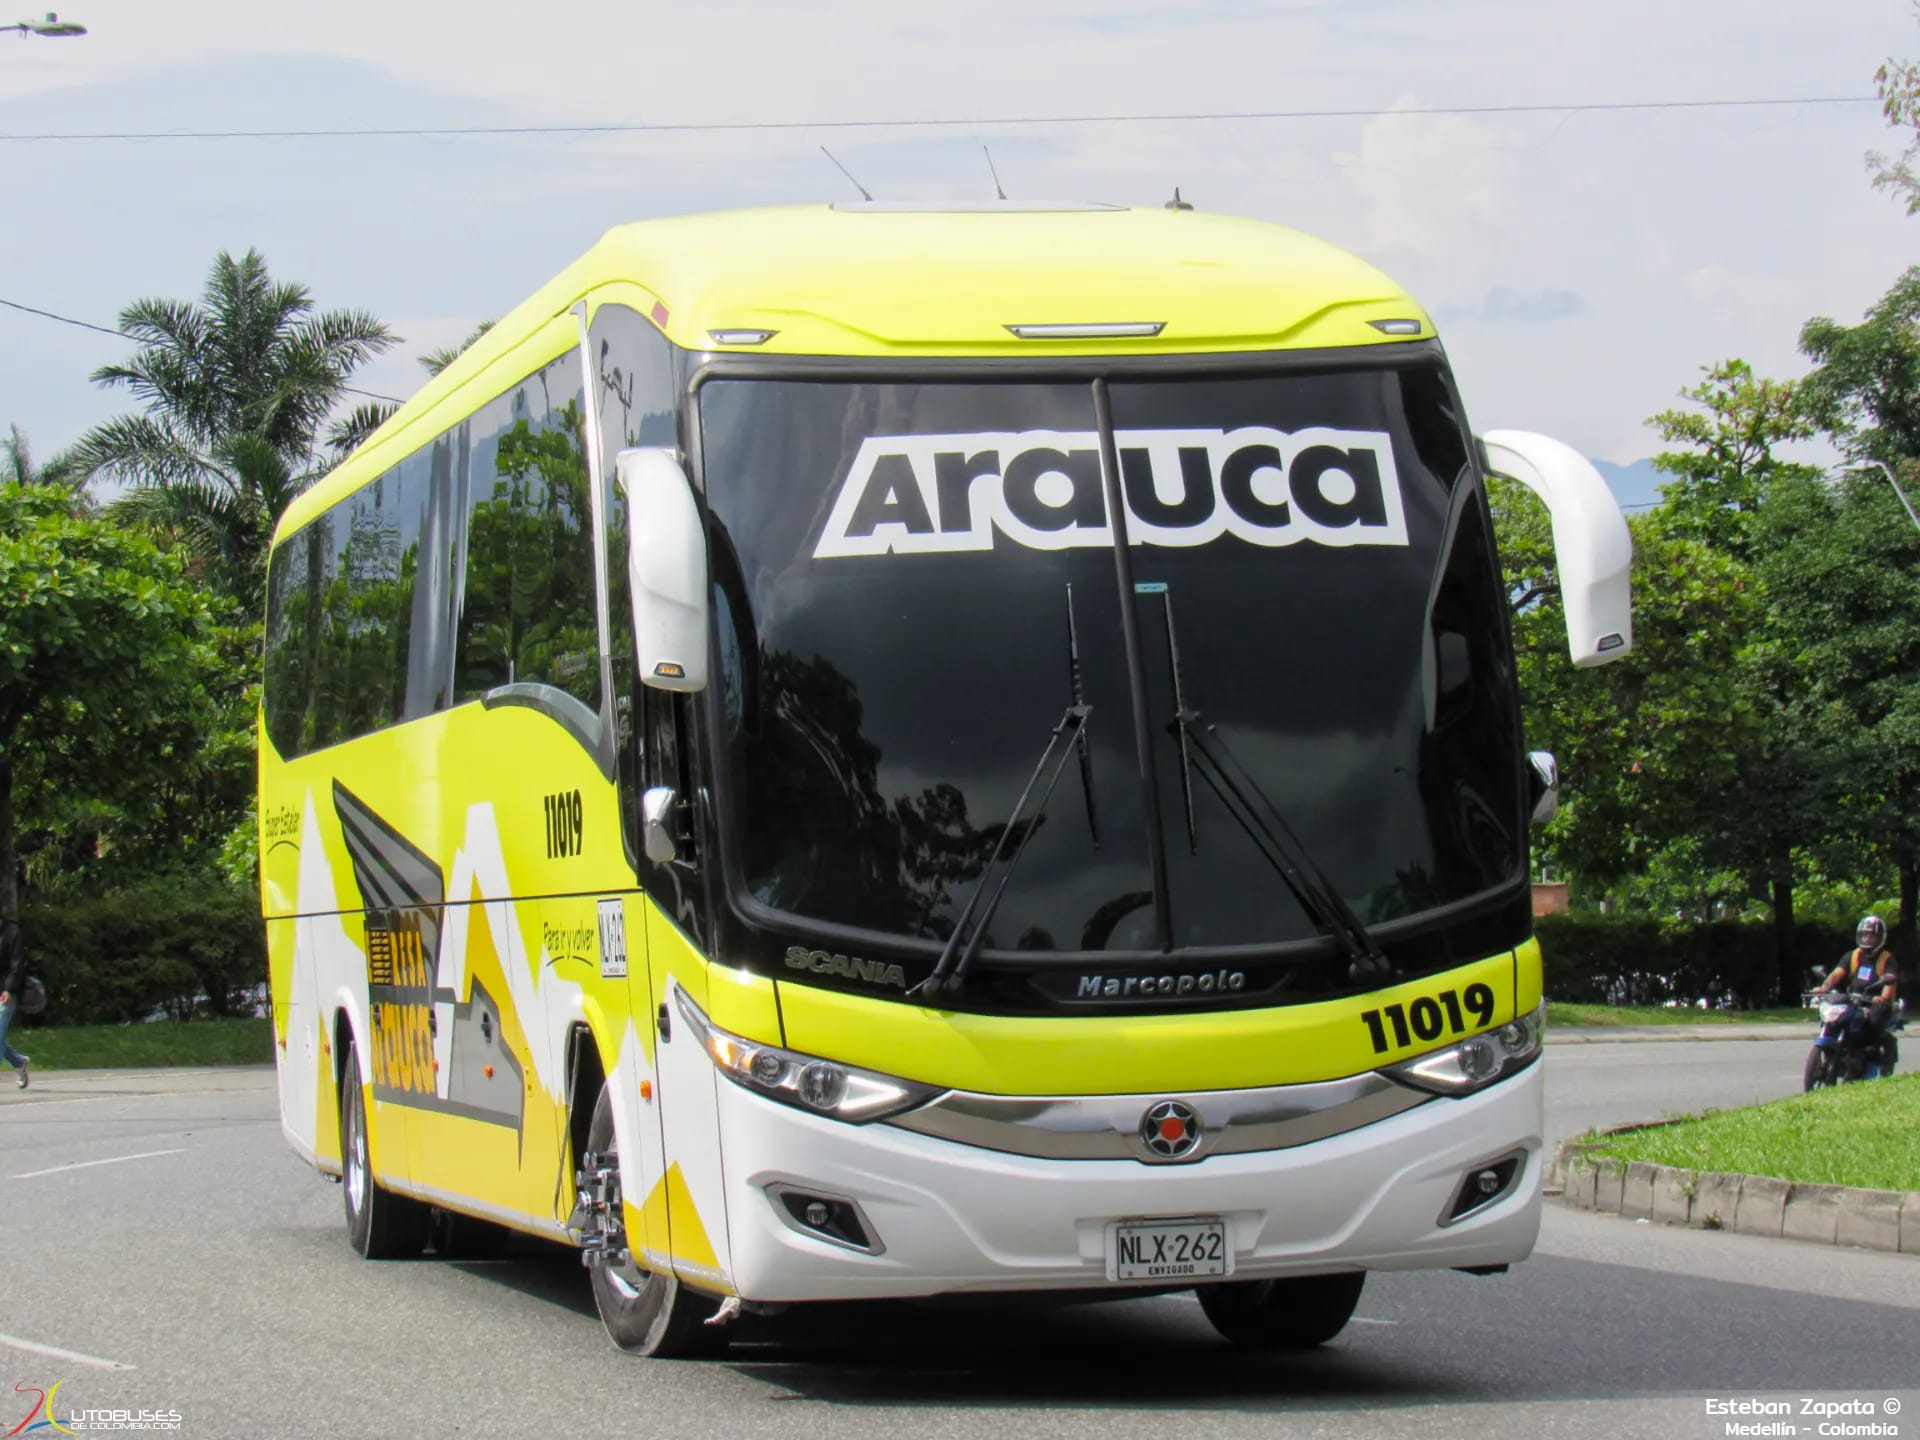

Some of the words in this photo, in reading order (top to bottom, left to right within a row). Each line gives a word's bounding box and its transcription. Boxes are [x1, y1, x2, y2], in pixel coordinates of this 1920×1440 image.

[843, 441, 1390, 538] Arauca
[544, 788, 583, 859] 11019
[543, 921, 560, 951] Para
[573, 919, 595, 951] volver
[784, 945, 906, 988] SCANIA
[1076, 969, 1245, 997] Marcopolo
[1361, 982, 1495, 1055] 11019
[1148, 1264, 1194, 1276] ENVIGADO
